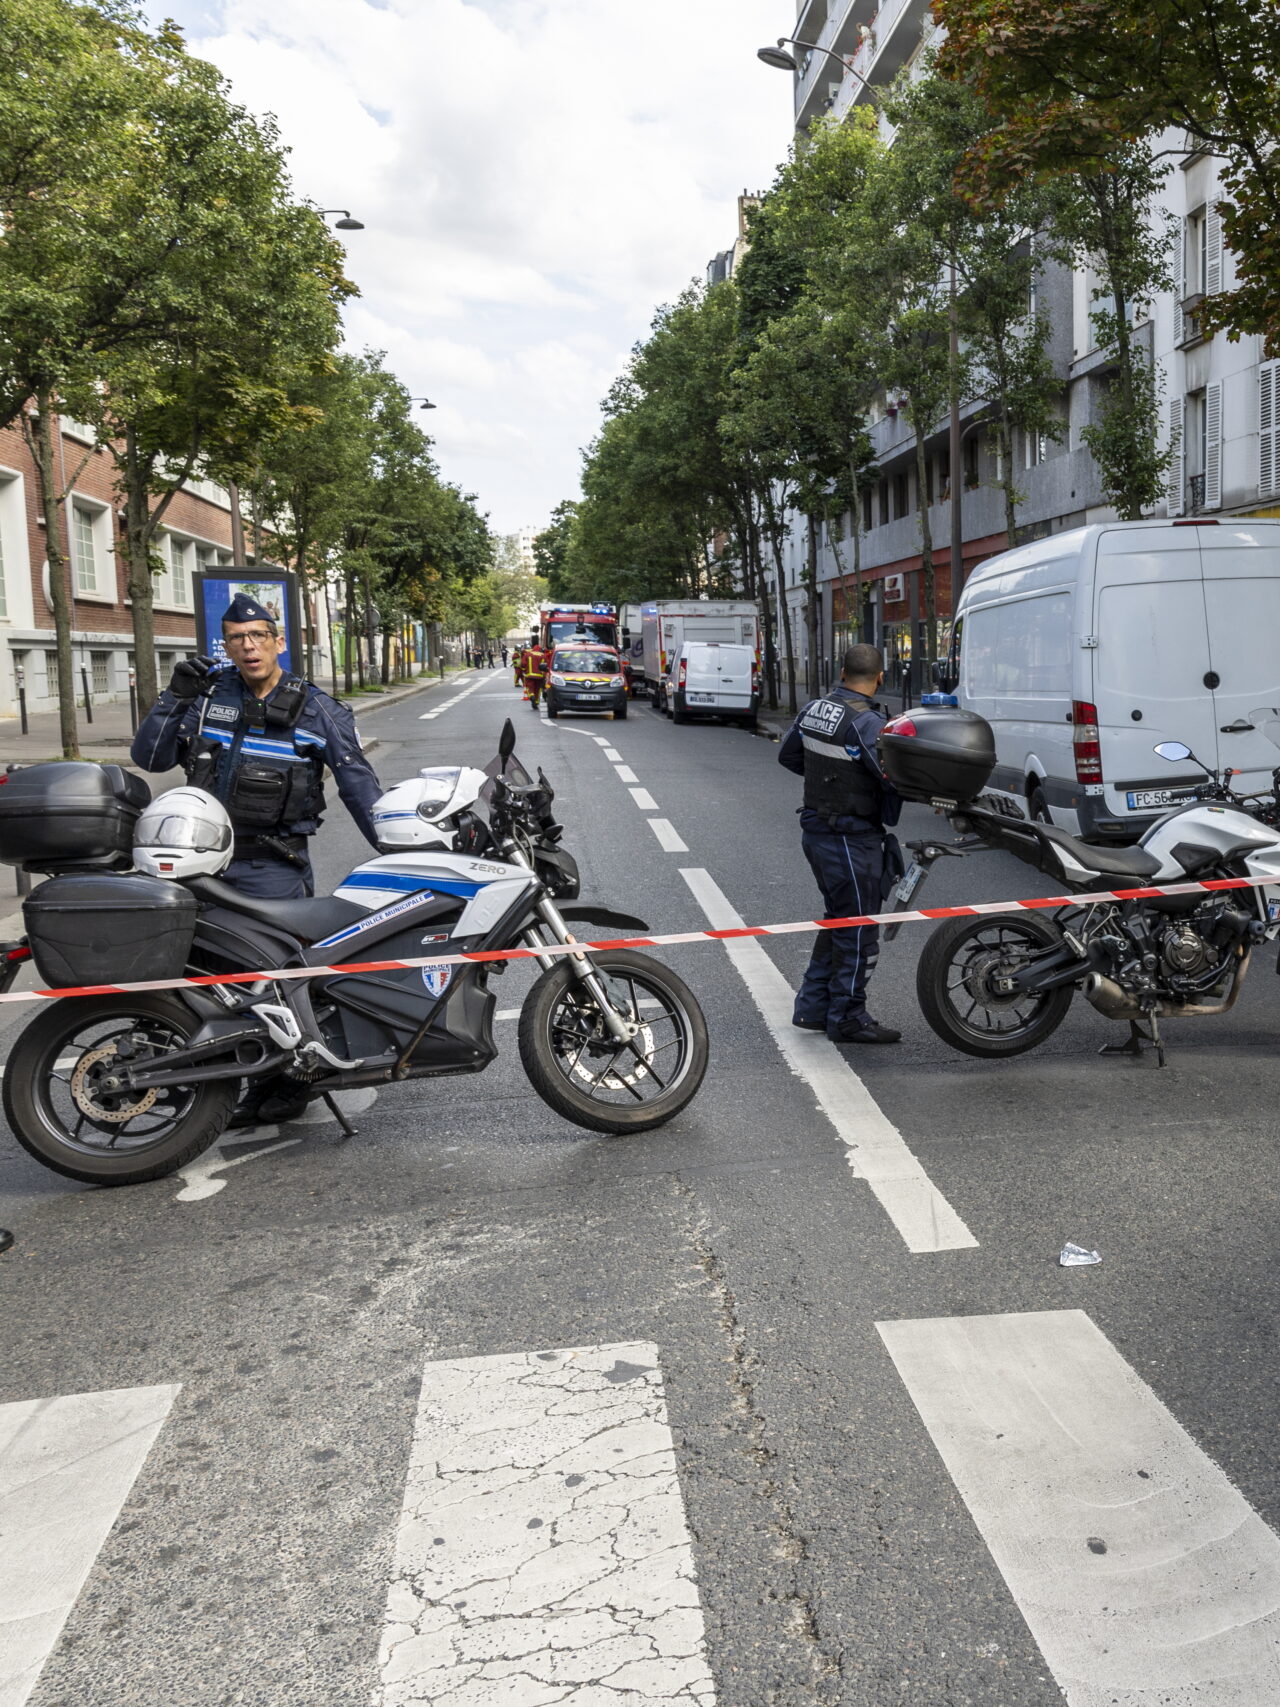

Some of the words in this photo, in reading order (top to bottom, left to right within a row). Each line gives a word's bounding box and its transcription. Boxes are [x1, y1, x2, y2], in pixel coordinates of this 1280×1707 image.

[211, 707, 237, 716] POLICE
[469, 862, 507, 875] ZERO
[361, 915, 383, 929] POLICE
[385, 896, 424, 918] MUNICIPALE
